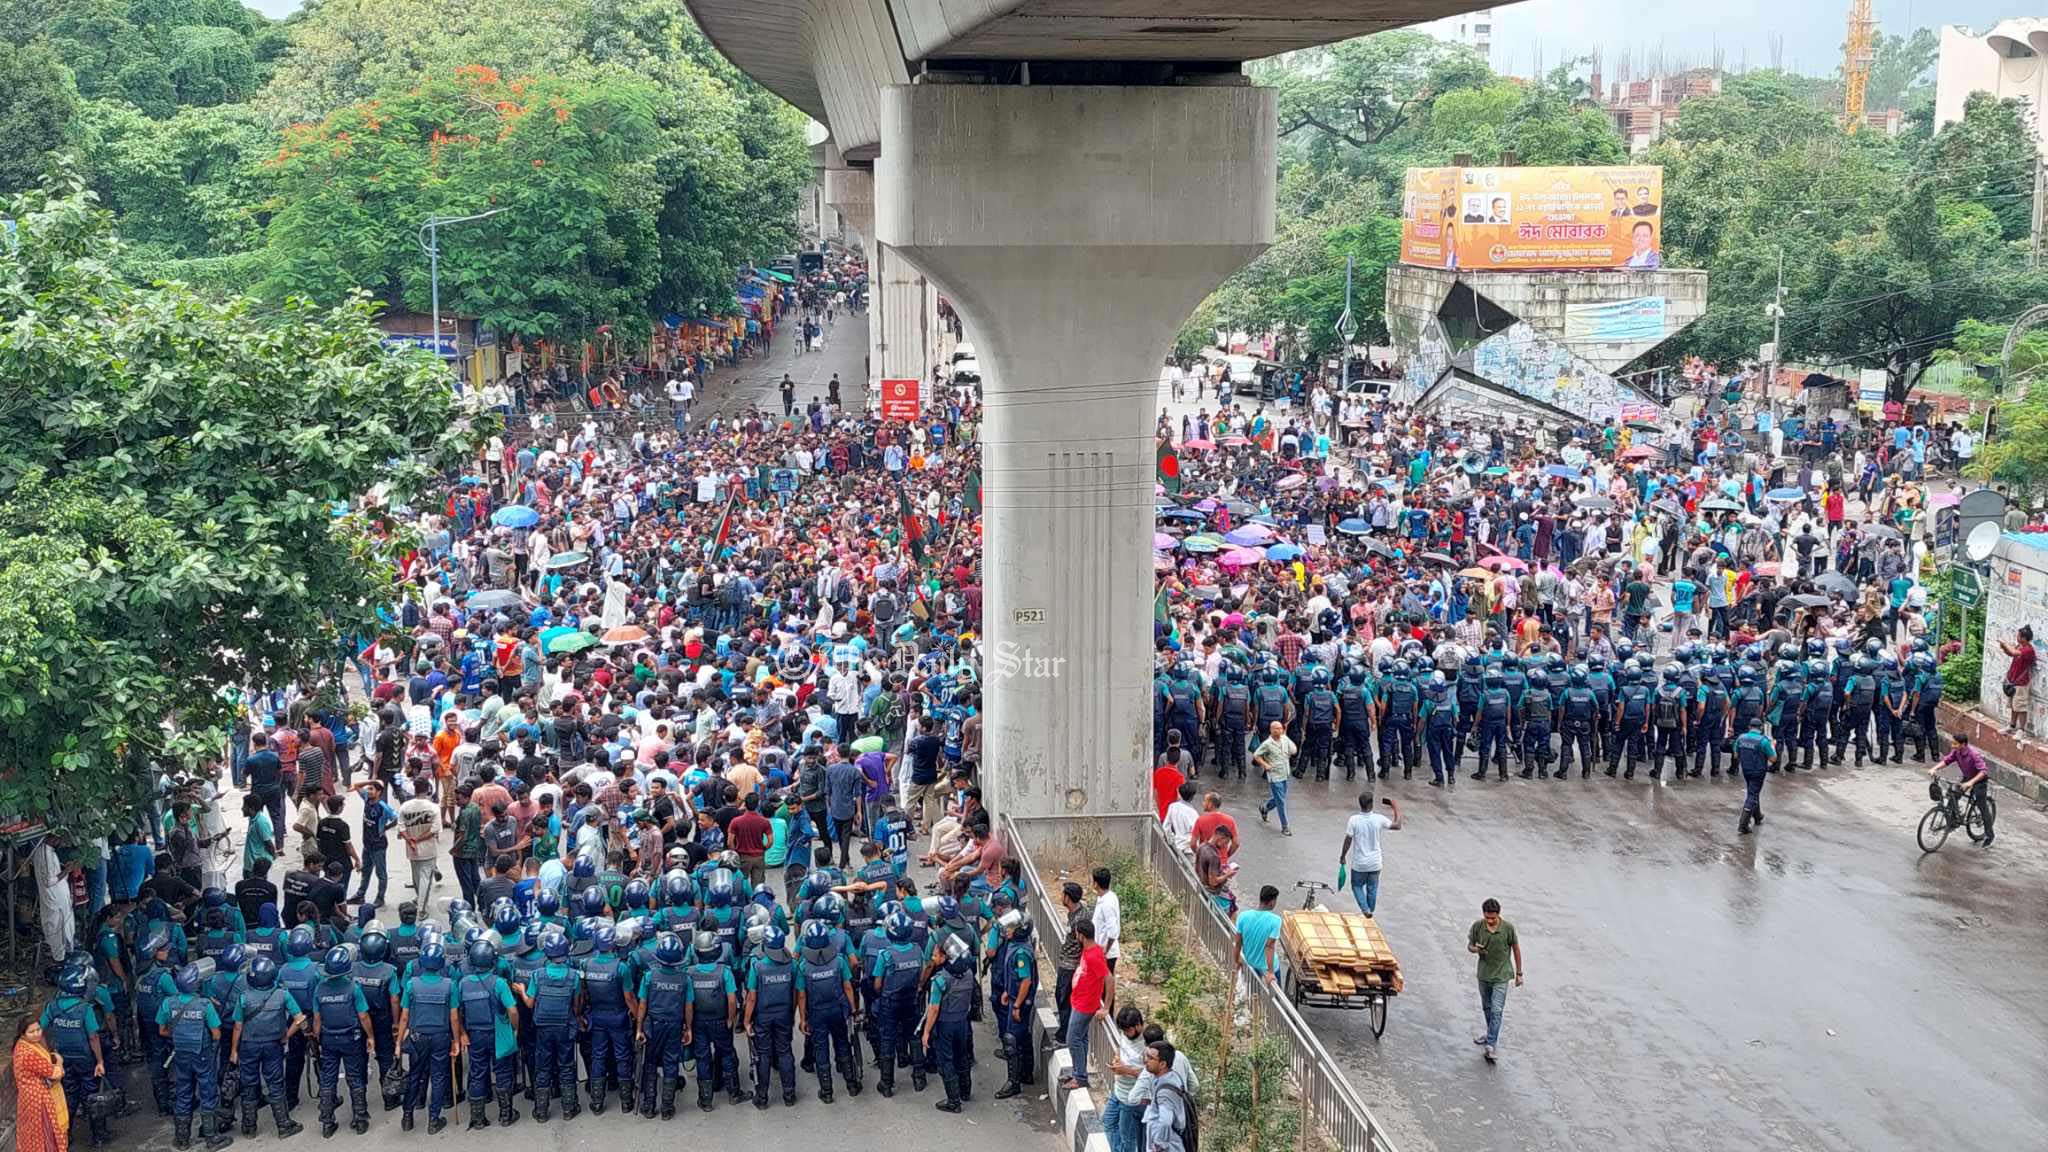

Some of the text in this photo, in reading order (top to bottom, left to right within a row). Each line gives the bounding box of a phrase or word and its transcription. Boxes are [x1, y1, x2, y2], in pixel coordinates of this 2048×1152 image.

[1519, 222, 1608, 240] ঈদ মোবারক
[1015, 610, 1045, 622] P521
[889, 831, 906, 851] 01
[866, 866, 891, 878] POLICE
[765, 974, 788, 983] POLICE
[656, 982, 681, 991] POLICE
[53, 1018, 82, 1029] POLICE
